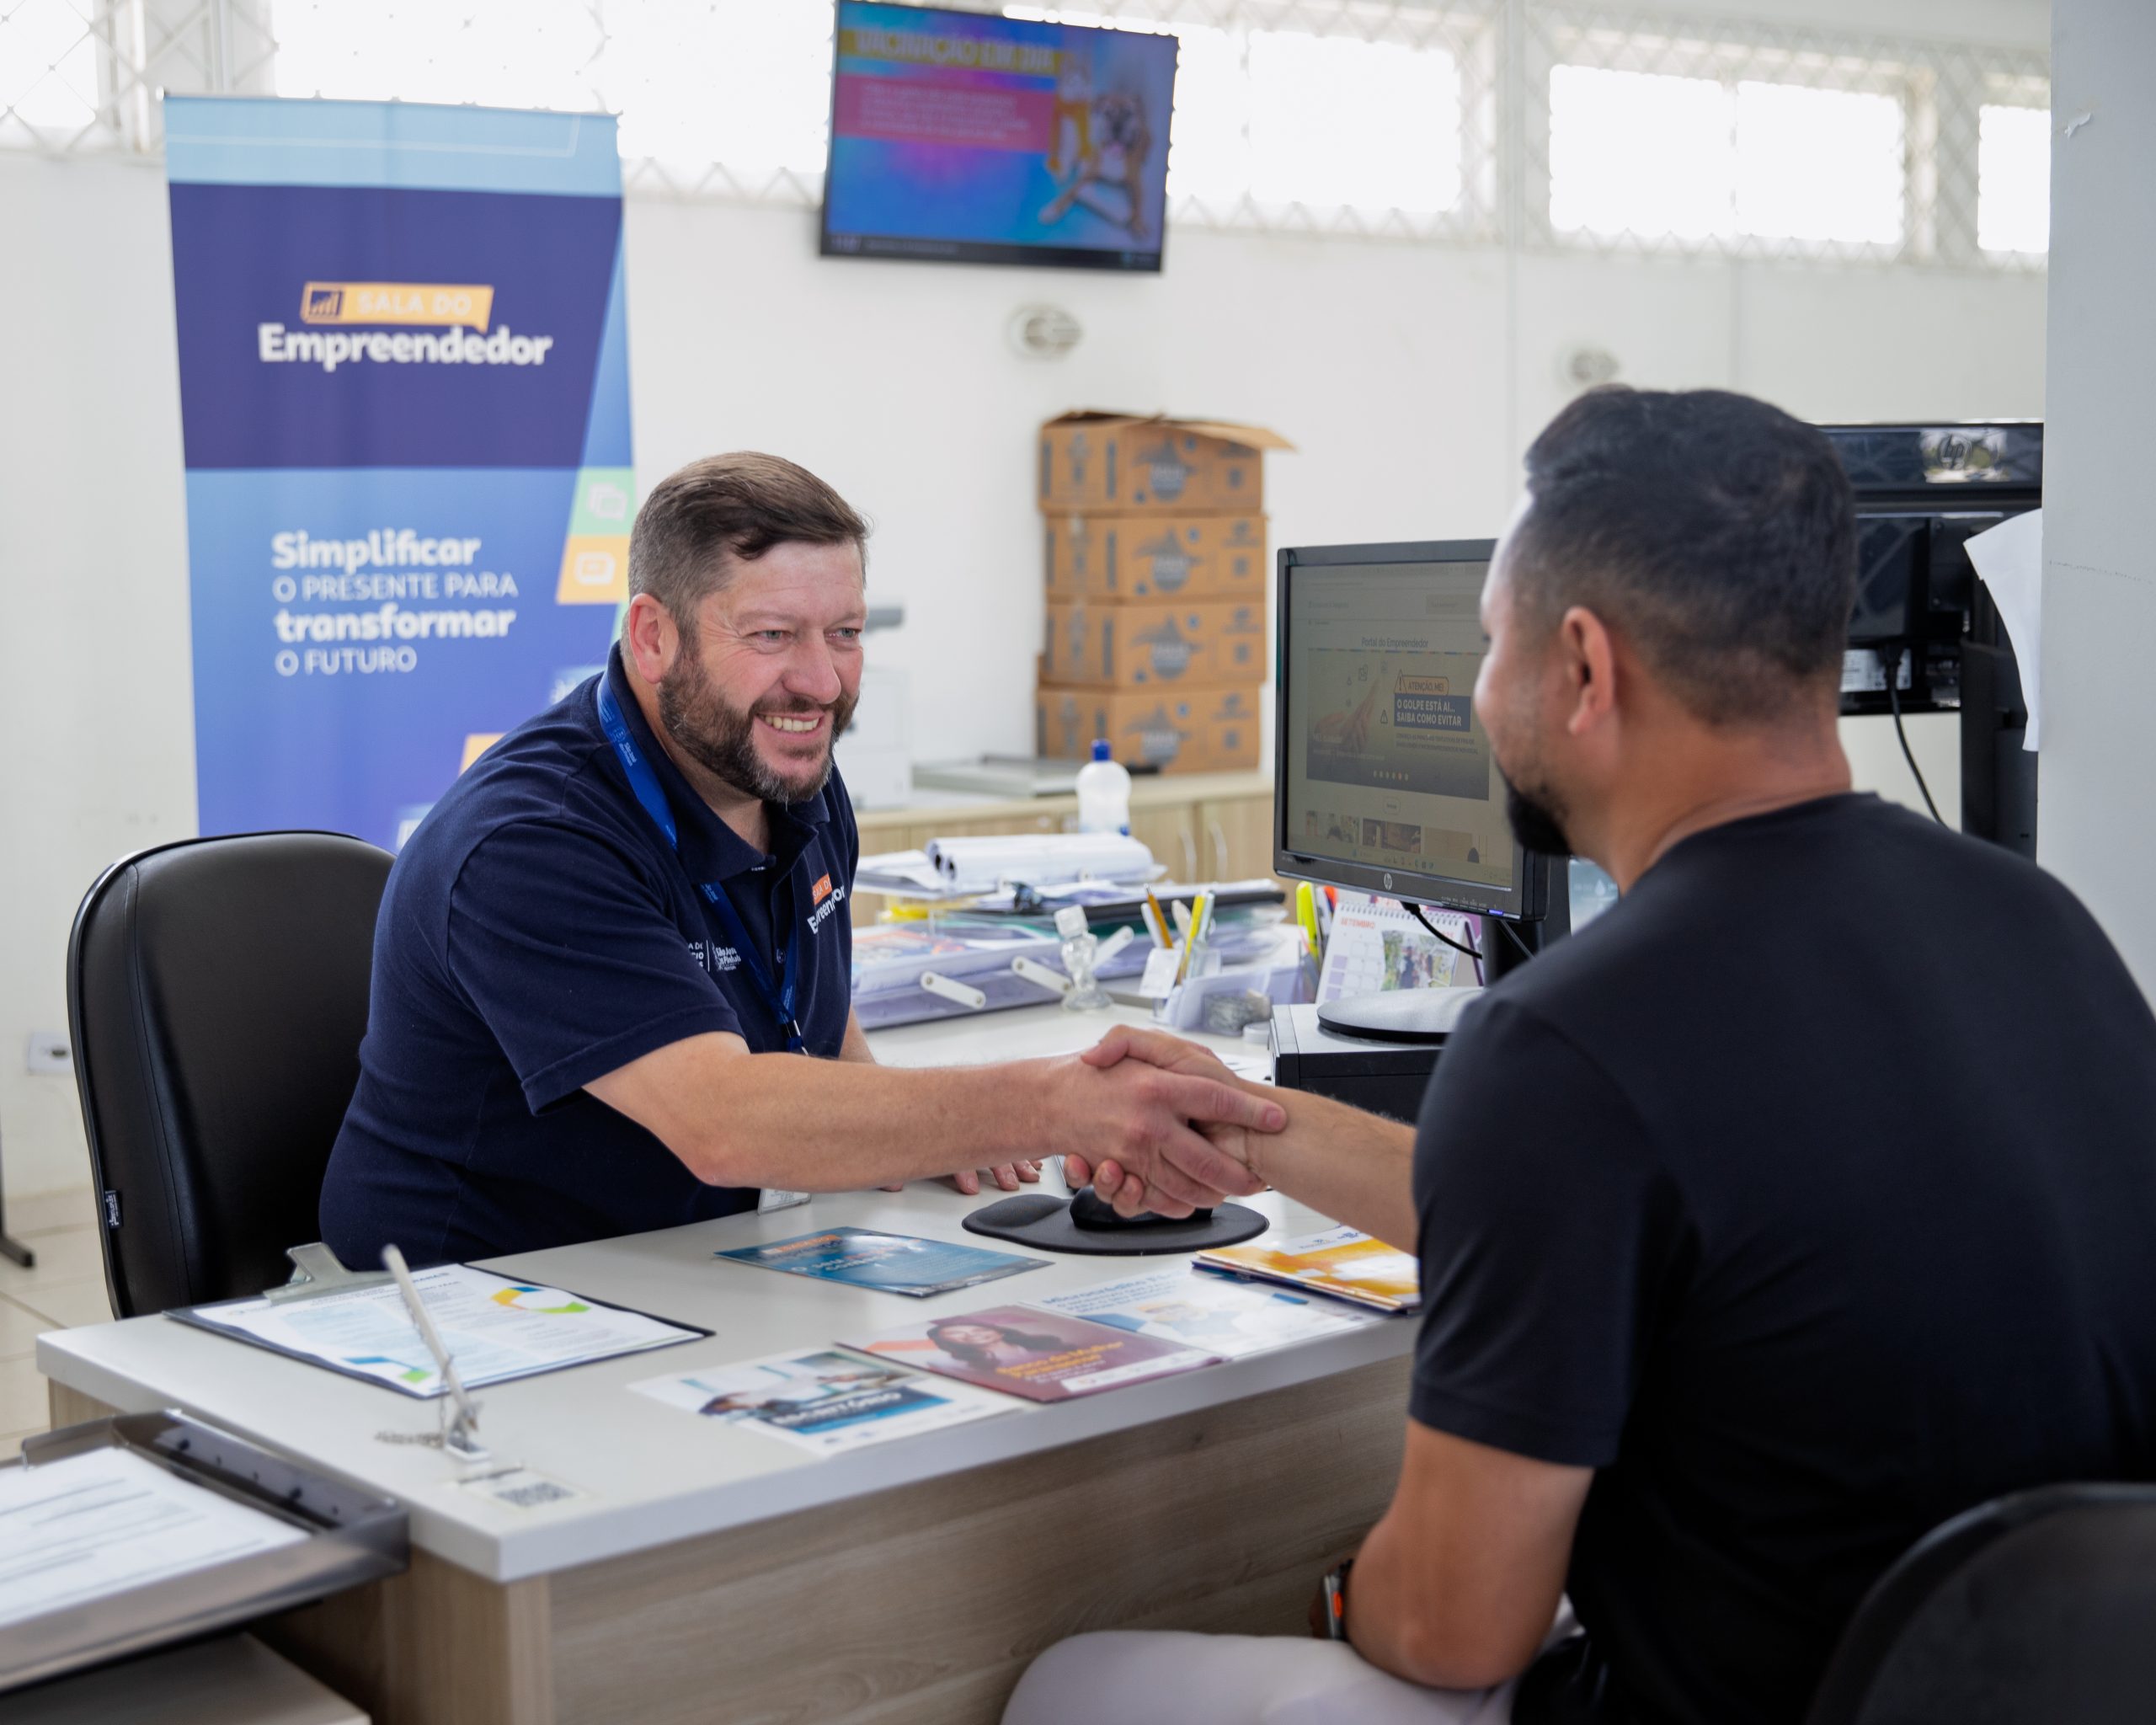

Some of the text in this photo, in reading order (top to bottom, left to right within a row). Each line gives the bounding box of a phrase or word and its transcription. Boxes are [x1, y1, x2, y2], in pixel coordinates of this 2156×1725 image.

[357, 291, 472, 316] SALA DO
[259, 323, 553, 372] Empreendedor
[271, 527, 482, 575] Simplificar
[272, 571, 519, 602] O PRESENTE PARA
[274, 601, 516, 643] transformar
[1361, 637, 1429, 649] Portal do Empreendedor
[275, 645, 418, 676] O FUTURO
[1396, 699, 1402, 709] O
[1403, 699, 1424, 711] GOLPE
[1425, 698, 1443, 713] ESTÁ
[1396, 712, 1462, 727] SAIBA COMO EVITAR
